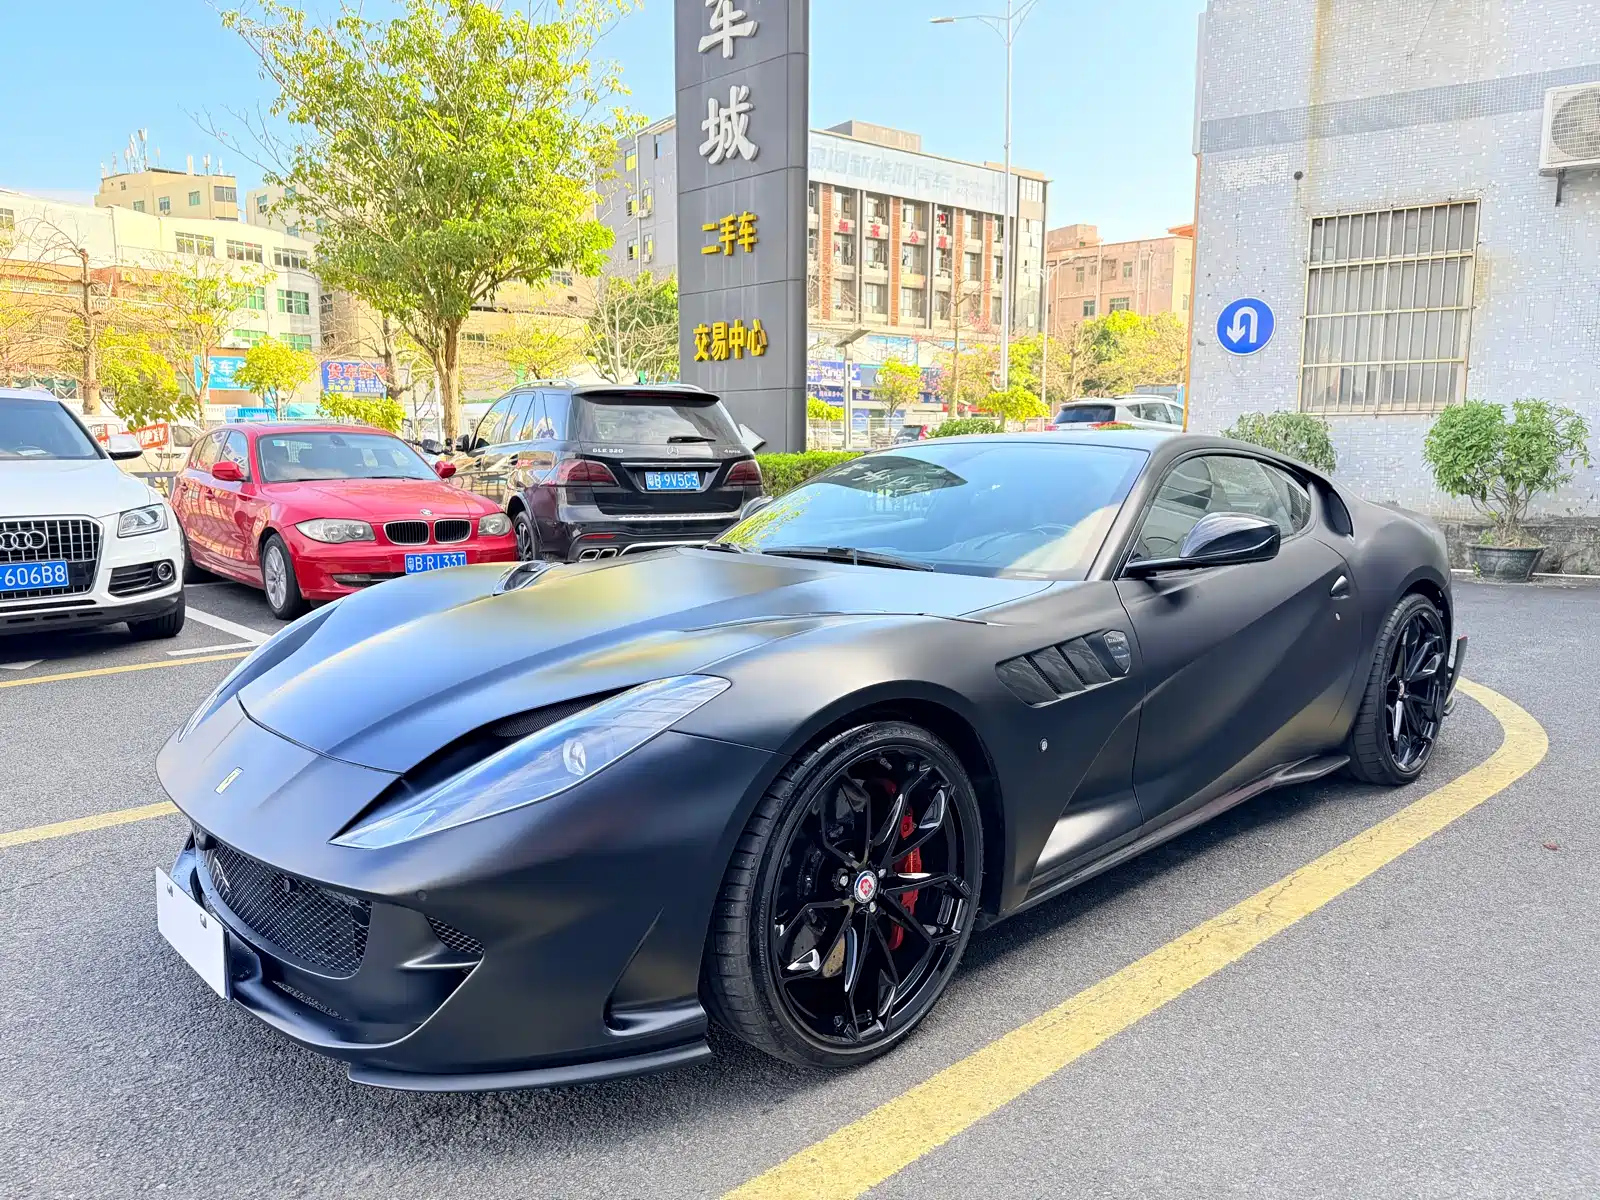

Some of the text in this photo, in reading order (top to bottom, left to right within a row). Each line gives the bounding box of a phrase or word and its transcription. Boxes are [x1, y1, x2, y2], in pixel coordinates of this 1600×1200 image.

[698, 0, 759, 164] 车城
[701, 211, 758, 256] 二手车
[693, 319, 768, 361] 交易中心
